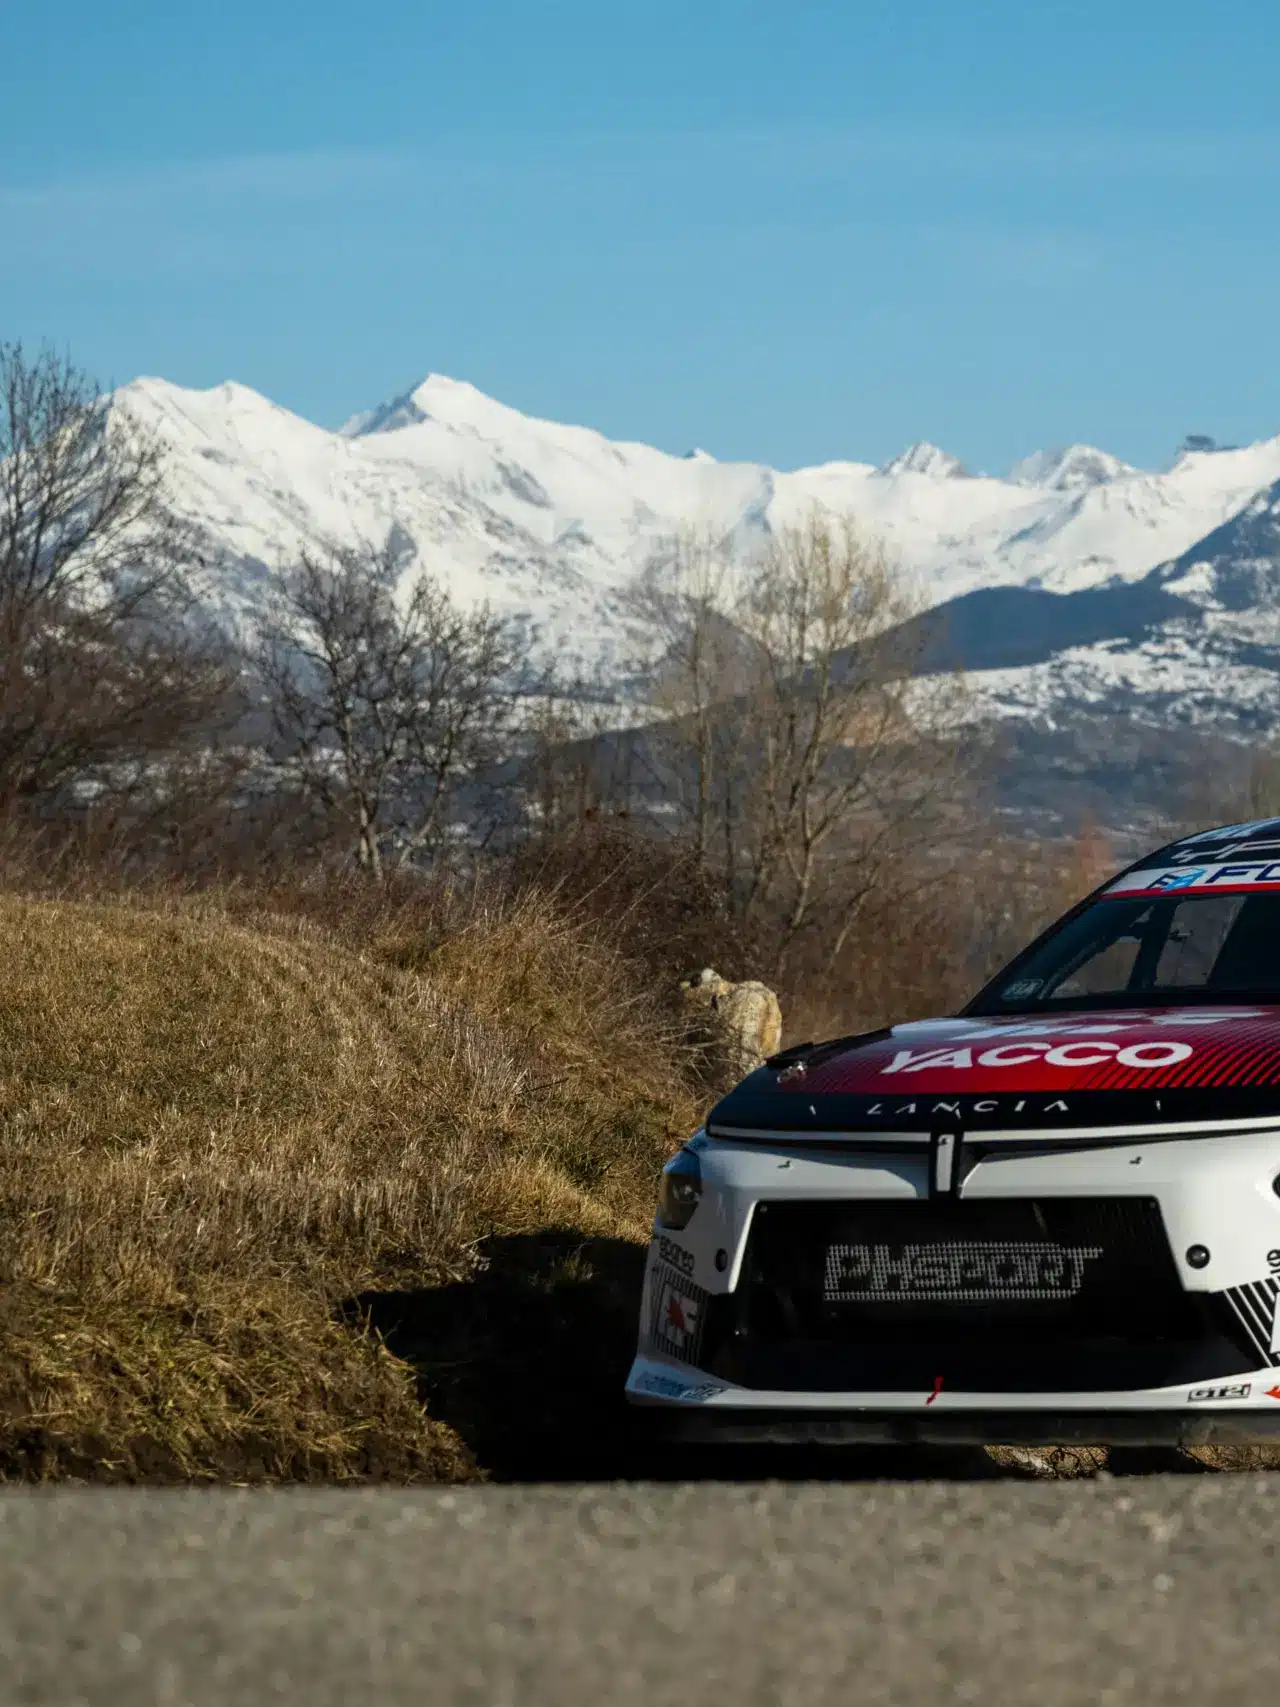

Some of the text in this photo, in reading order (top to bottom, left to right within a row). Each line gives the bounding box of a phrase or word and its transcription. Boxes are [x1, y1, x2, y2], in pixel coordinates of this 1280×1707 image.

[881, 1042, 1193, 1074] YACCO
[866, 1101, 1070, 1115] LANCIA
[824, 1243, 1103, 1300] PHSPORT
